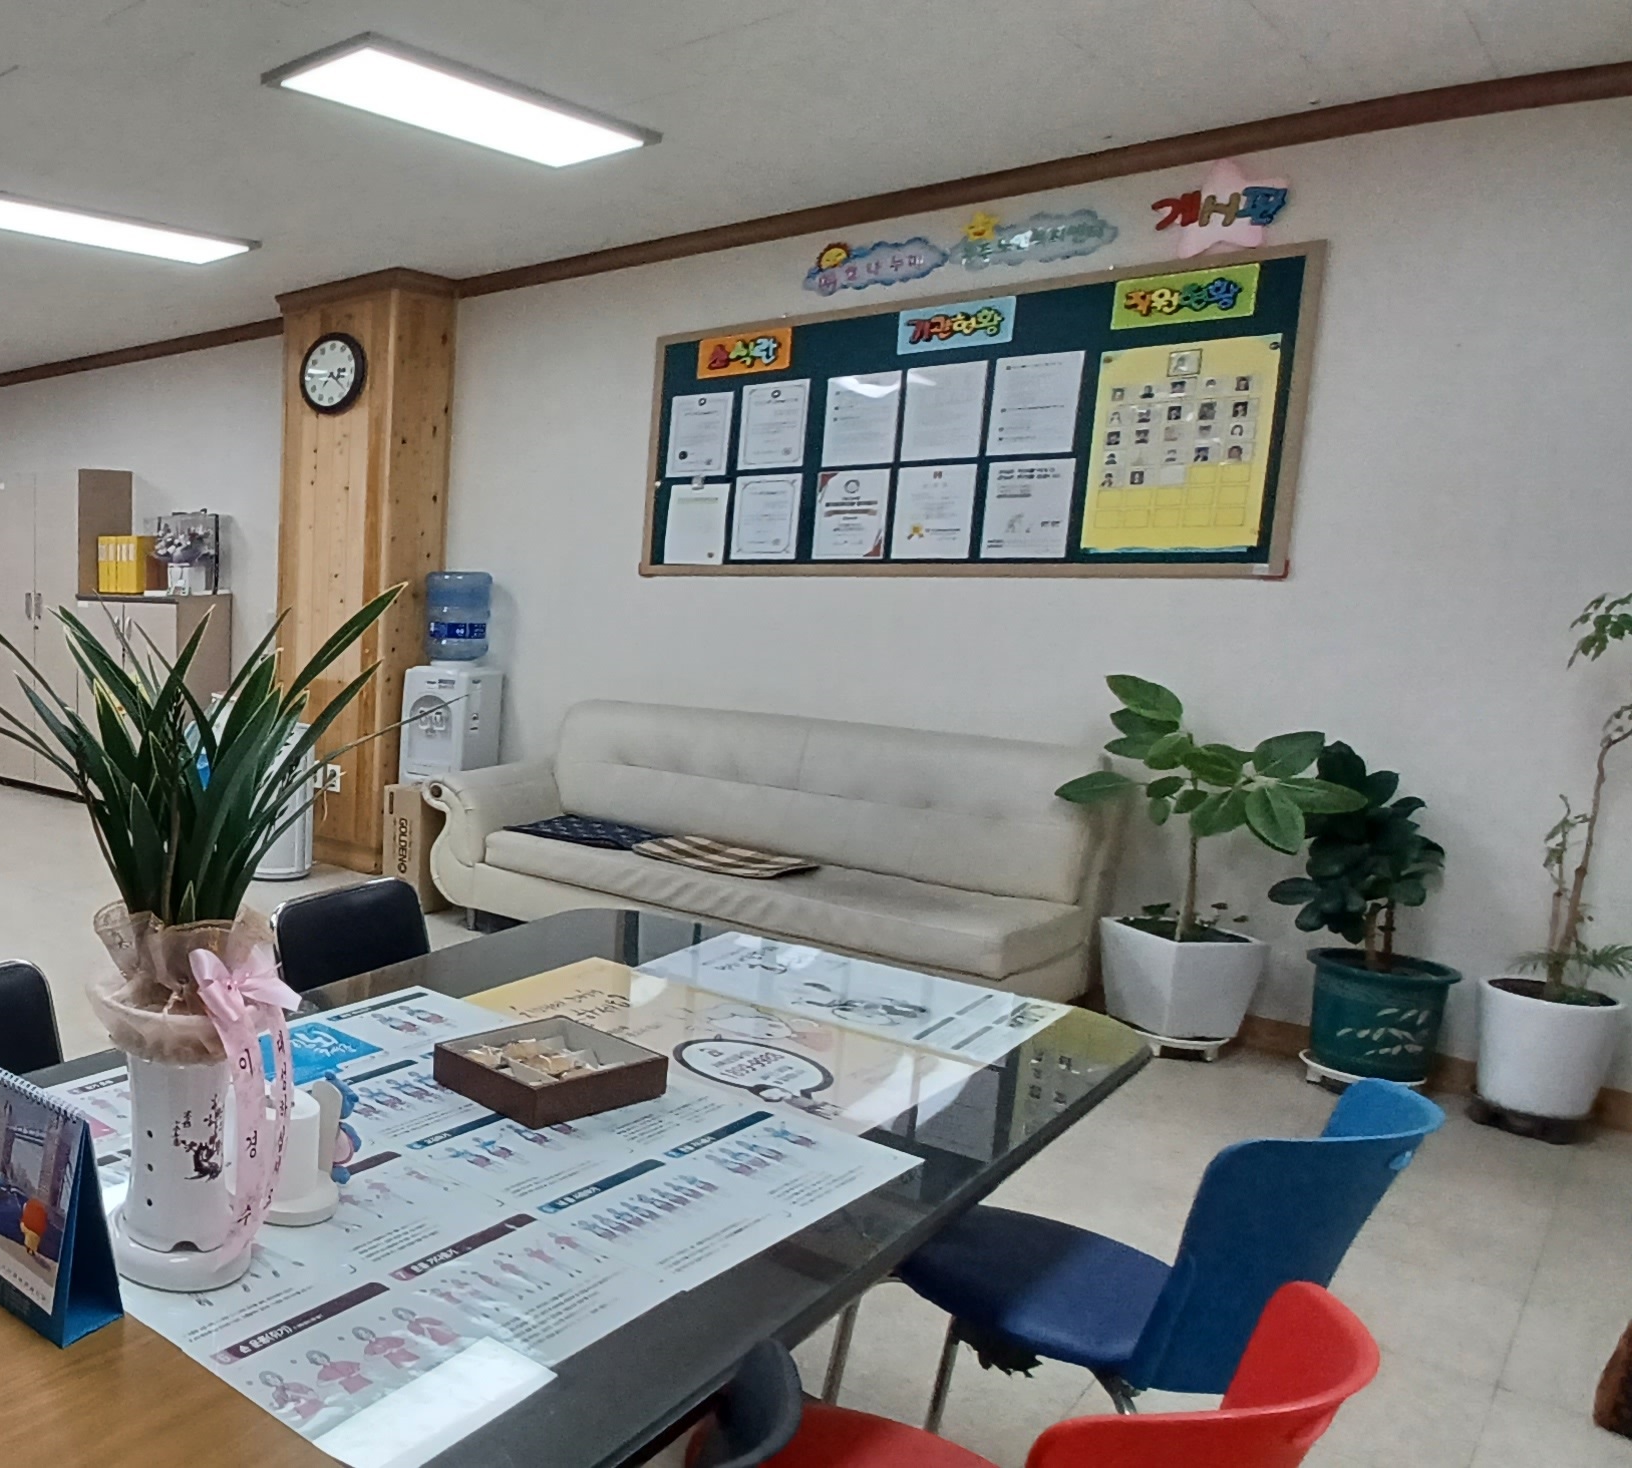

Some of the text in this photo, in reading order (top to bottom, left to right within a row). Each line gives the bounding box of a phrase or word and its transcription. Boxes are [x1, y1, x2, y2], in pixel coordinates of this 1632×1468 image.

[1151, 186, 1288, 231] 게시판
[1124, 278, 1242, 315] 직원현황
[906, 307, 1005, 344] 기관현황
[708, 337, 779, 370] 소식란
